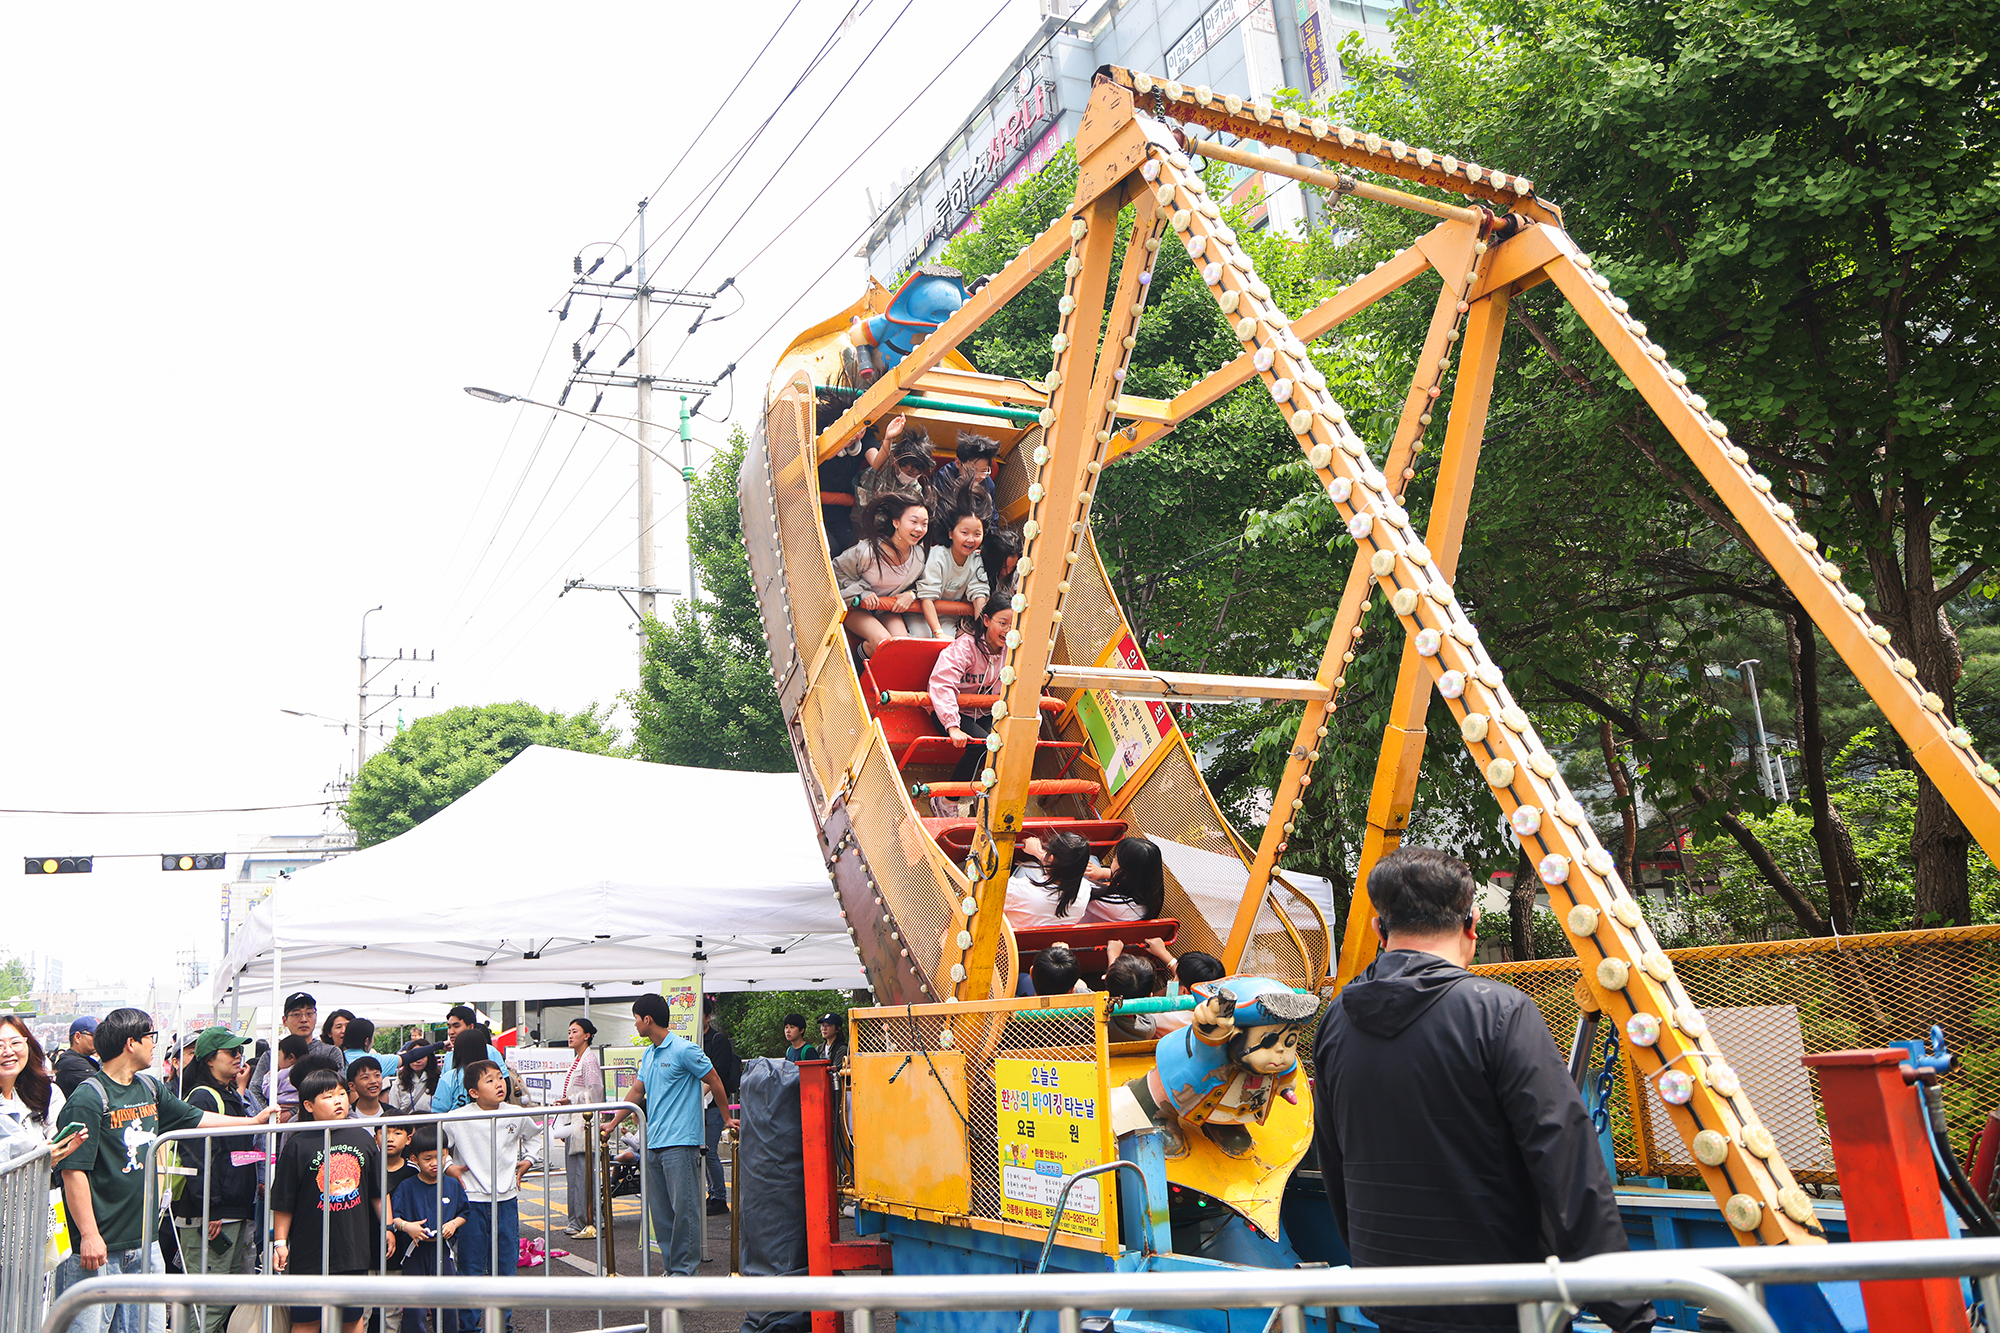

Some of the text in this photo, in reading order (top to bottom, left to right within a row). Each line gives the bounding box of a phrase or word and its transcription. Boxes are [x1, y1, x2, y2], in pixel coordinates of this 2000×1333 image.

[1168, 27, 1204, 69] 이안골프
[1205, 0, 1237, 30] 아카데
[1031, 1067, 1059, 1087] 오늘은
[1001, 1089, 1095, 1119] 환상의 바이킹 타는날
[1017, 1120, 1079, 1143] 요금 원
[323, 1144, 353, 1155] curage
